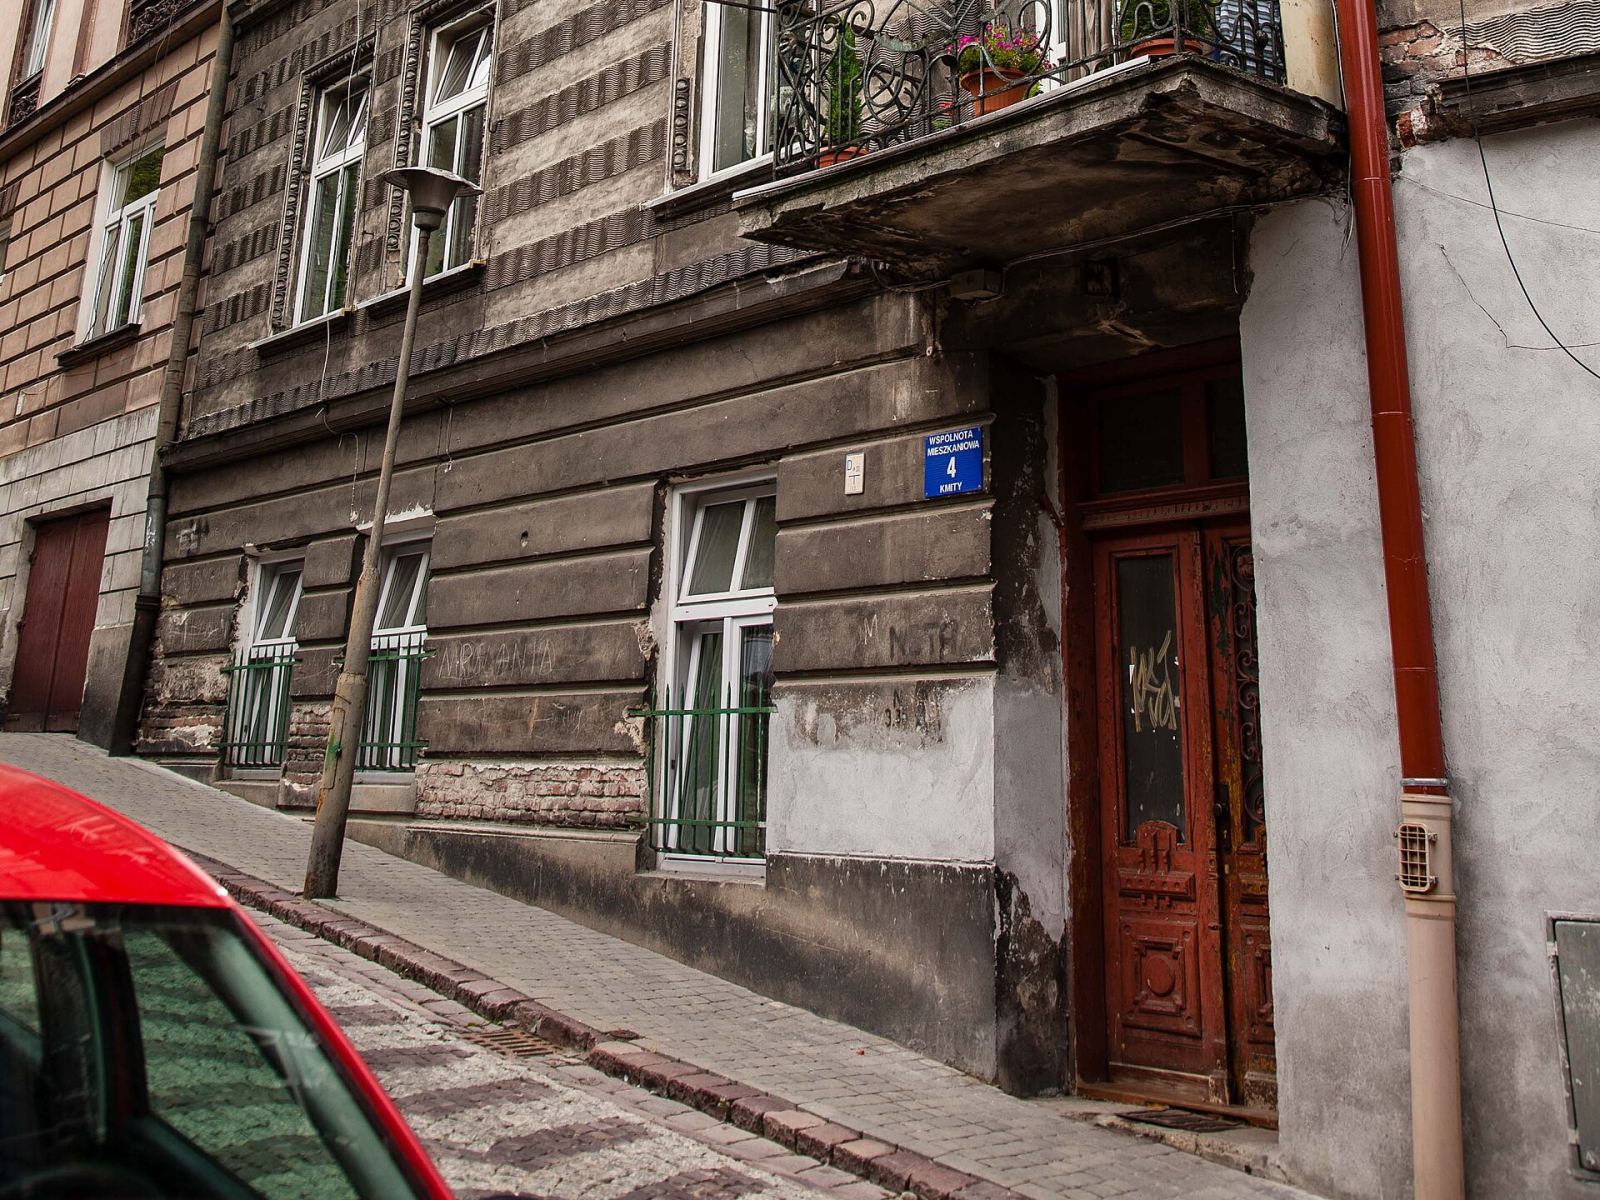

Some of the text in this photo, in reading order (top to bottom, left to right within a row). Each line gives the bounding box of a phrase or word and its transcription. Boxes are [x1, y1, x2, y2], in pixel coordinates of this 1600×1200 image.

[927, 440, 980, 456] MIESZKANIOWA
[947, 456, 956, 478] 4
[939, 481, 962, 493] KMITY
